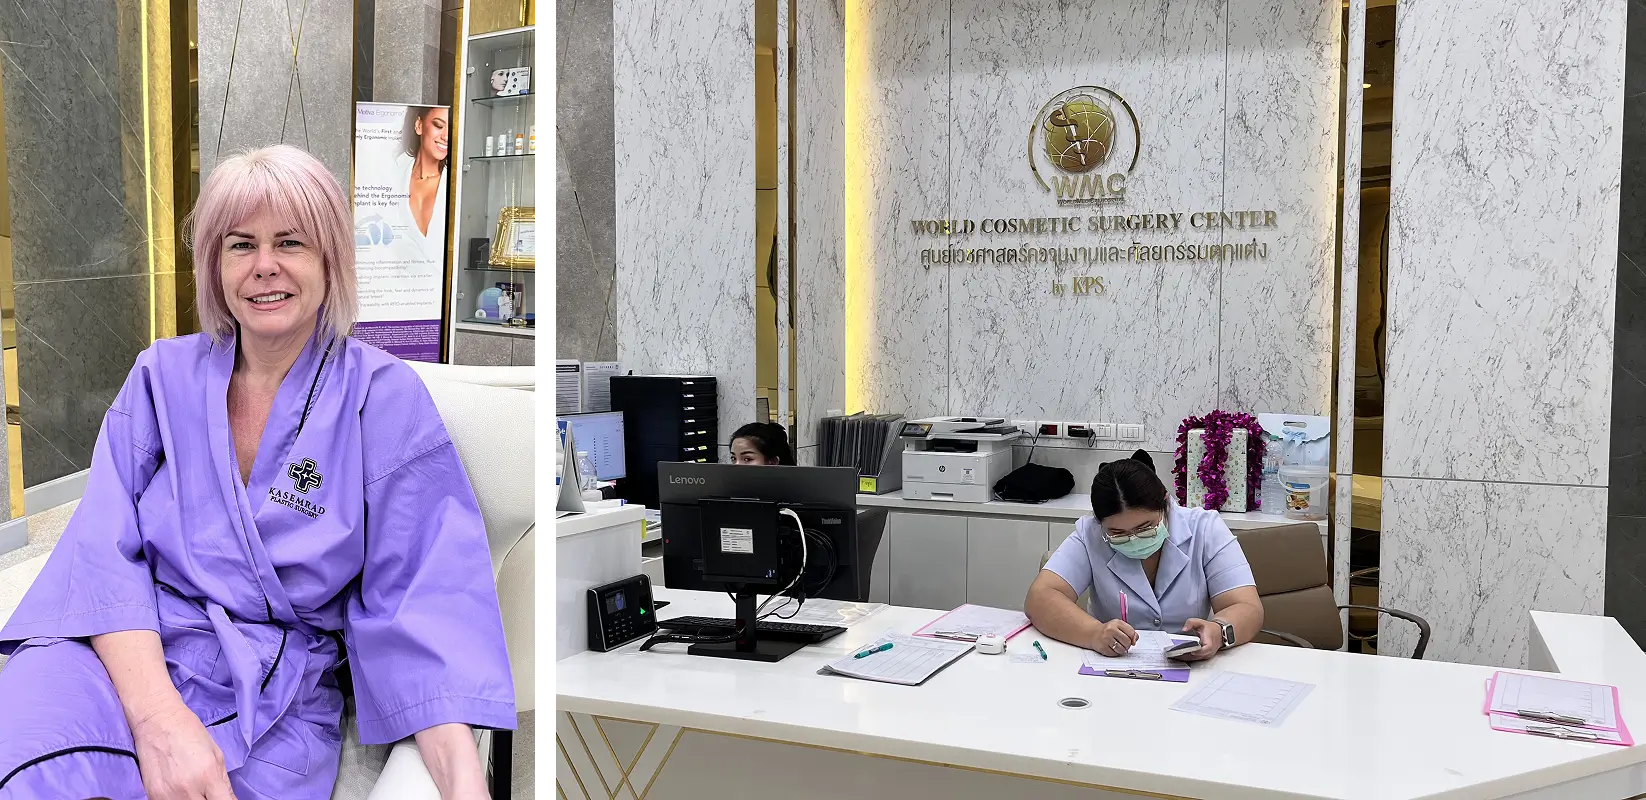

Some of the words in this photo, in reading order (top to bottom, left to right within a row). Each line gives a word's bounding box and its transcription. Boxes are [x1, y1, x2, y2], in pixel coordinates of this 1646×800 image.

[362, 185, 393, 193] technology
[1050, 173, 1127, 197] WMC
[381, 192, 411, 201] Ergonomix
[911, 219, 975, 235] WORLD
[980, 216, 1081, 235] COSMETIC
[1087, 213, 1183, 232] SURGERY
[1190, 211, 1278, 230] CENTER
[1052, 280, 1066, 297] by
[669, 475, 706, 485] Lenovo
[269, 487, 326, 515] KASEMRAD
[270, 496, 294, 508] PLASTIC
[294, 505, 319, 519] SURGERY
